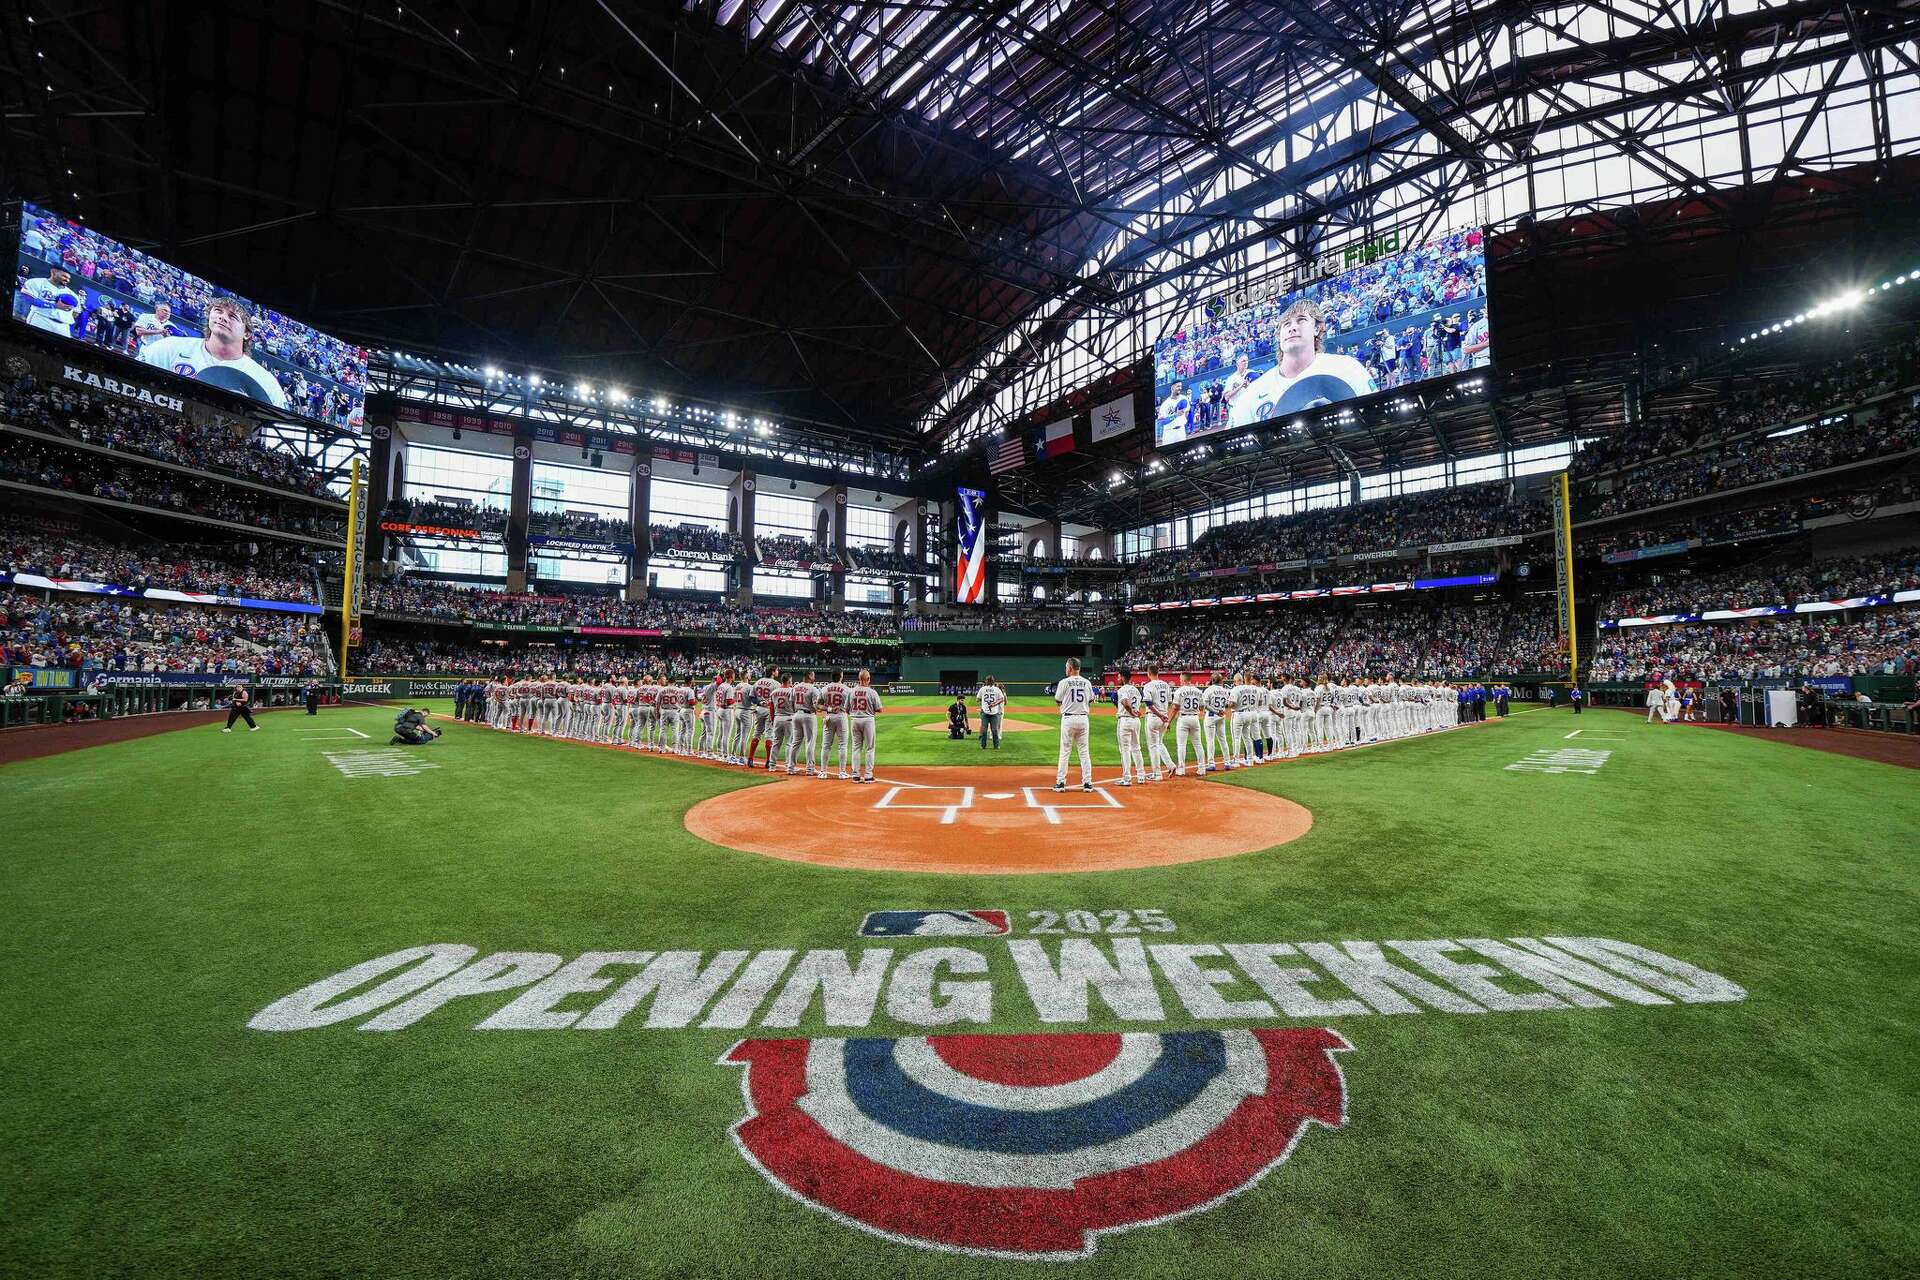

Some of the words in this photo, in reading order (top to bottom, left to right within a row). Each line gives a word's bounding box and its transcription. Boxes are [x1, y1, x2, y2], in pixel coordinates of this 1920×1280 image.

[1232, 277, 1293, 308] Globe
[1297, 254, 1339, 284] Life
[1344, 229, 1400, 270] Field
[433, 411, 453, 421] 1998
[493, 421, 512, 430] 2010
[373, 428, 388, 439] 42
[536, 427, 554, 436] 2010
[565, 432, 582, 440] 2011
[592, 436, 607, 444] 2011
[515, 447, 529, 457] 34
[638, 465, 650, 474] 26
[747, 481, 755, 490] 7
[380, 522, 412, 532] CORE
[546, 540, 580, 549] LOCKHEED
[581, 543, 607, 551] MARTIN
[711, 552, 735, 561] Bank
[1353, 550, 1398, 561] POWERADE
[1151, 574, 1176, 583] DALLAS
[97, 673, 161, 687] Germania
[260, 677, 295, 685] VICTORY
[343, 683, 392, 694] SEATGEEK
[795, 693, 804, 705] 11
[827, 694, 844, 706] 16
[984, 693, 995, 704] 25
[1070, 689, 1084, 702] 15
[1159, 691, 1166, 703] 5
[1322, 693, 1331, 702] 22
[777, 697, 786, 709] 2
[852, 699, 868, 711] 13
[1132, 697, 1137, 709] 2
[1184, 698, 1198, 709] 36
[1214, 698, 1225, 708] 53
[1027, 910, 1177, 934] 2025
[246, 943, 992, 1031] OPENING
[1006, 936, 1747, 1023] WEEKEND
